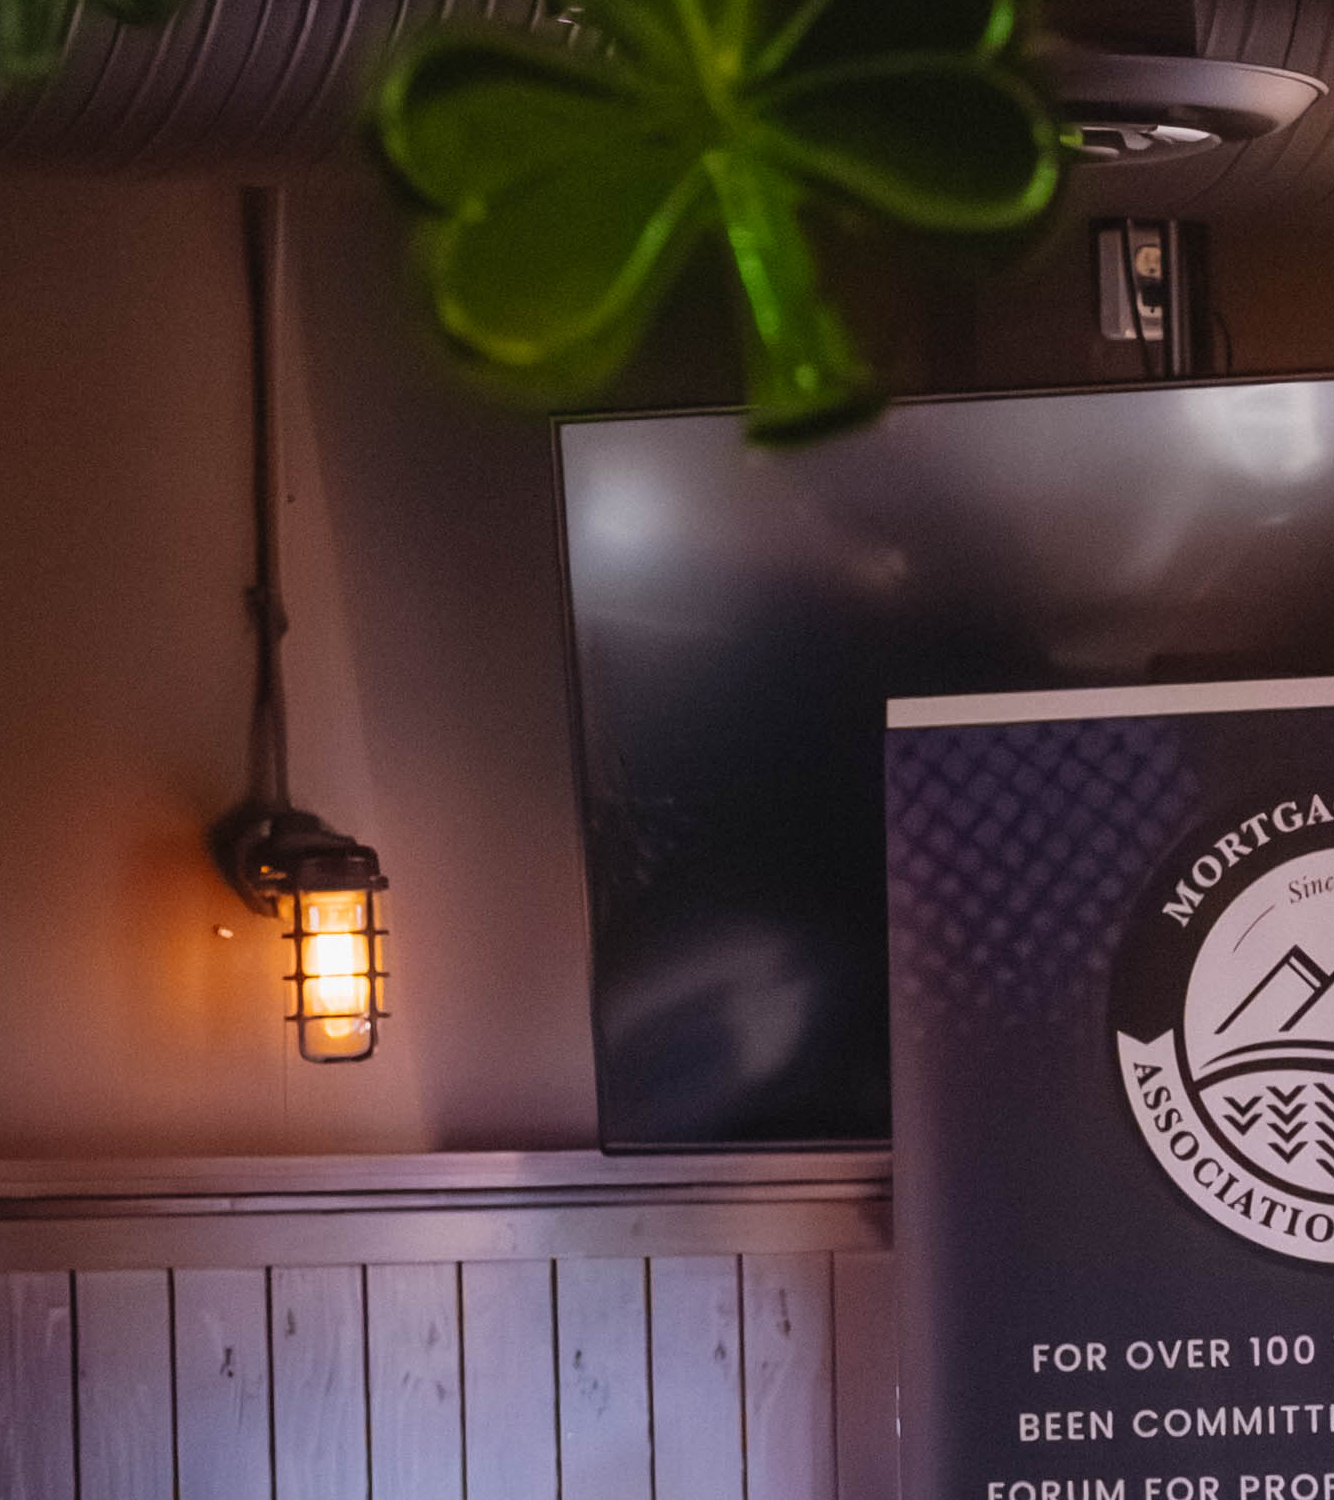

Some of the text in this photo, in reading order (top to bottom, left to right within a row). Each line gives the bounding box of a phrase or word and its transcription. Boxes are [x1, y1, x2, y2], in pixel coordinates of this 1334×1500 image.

[1033, 1342, 1107, 1373] FOR
[1126, 1339, 1230, 1370] OVER
[1249, 1335, 1315, 1367] 100
[1019, 1410, 1113, 1442] BEEN
